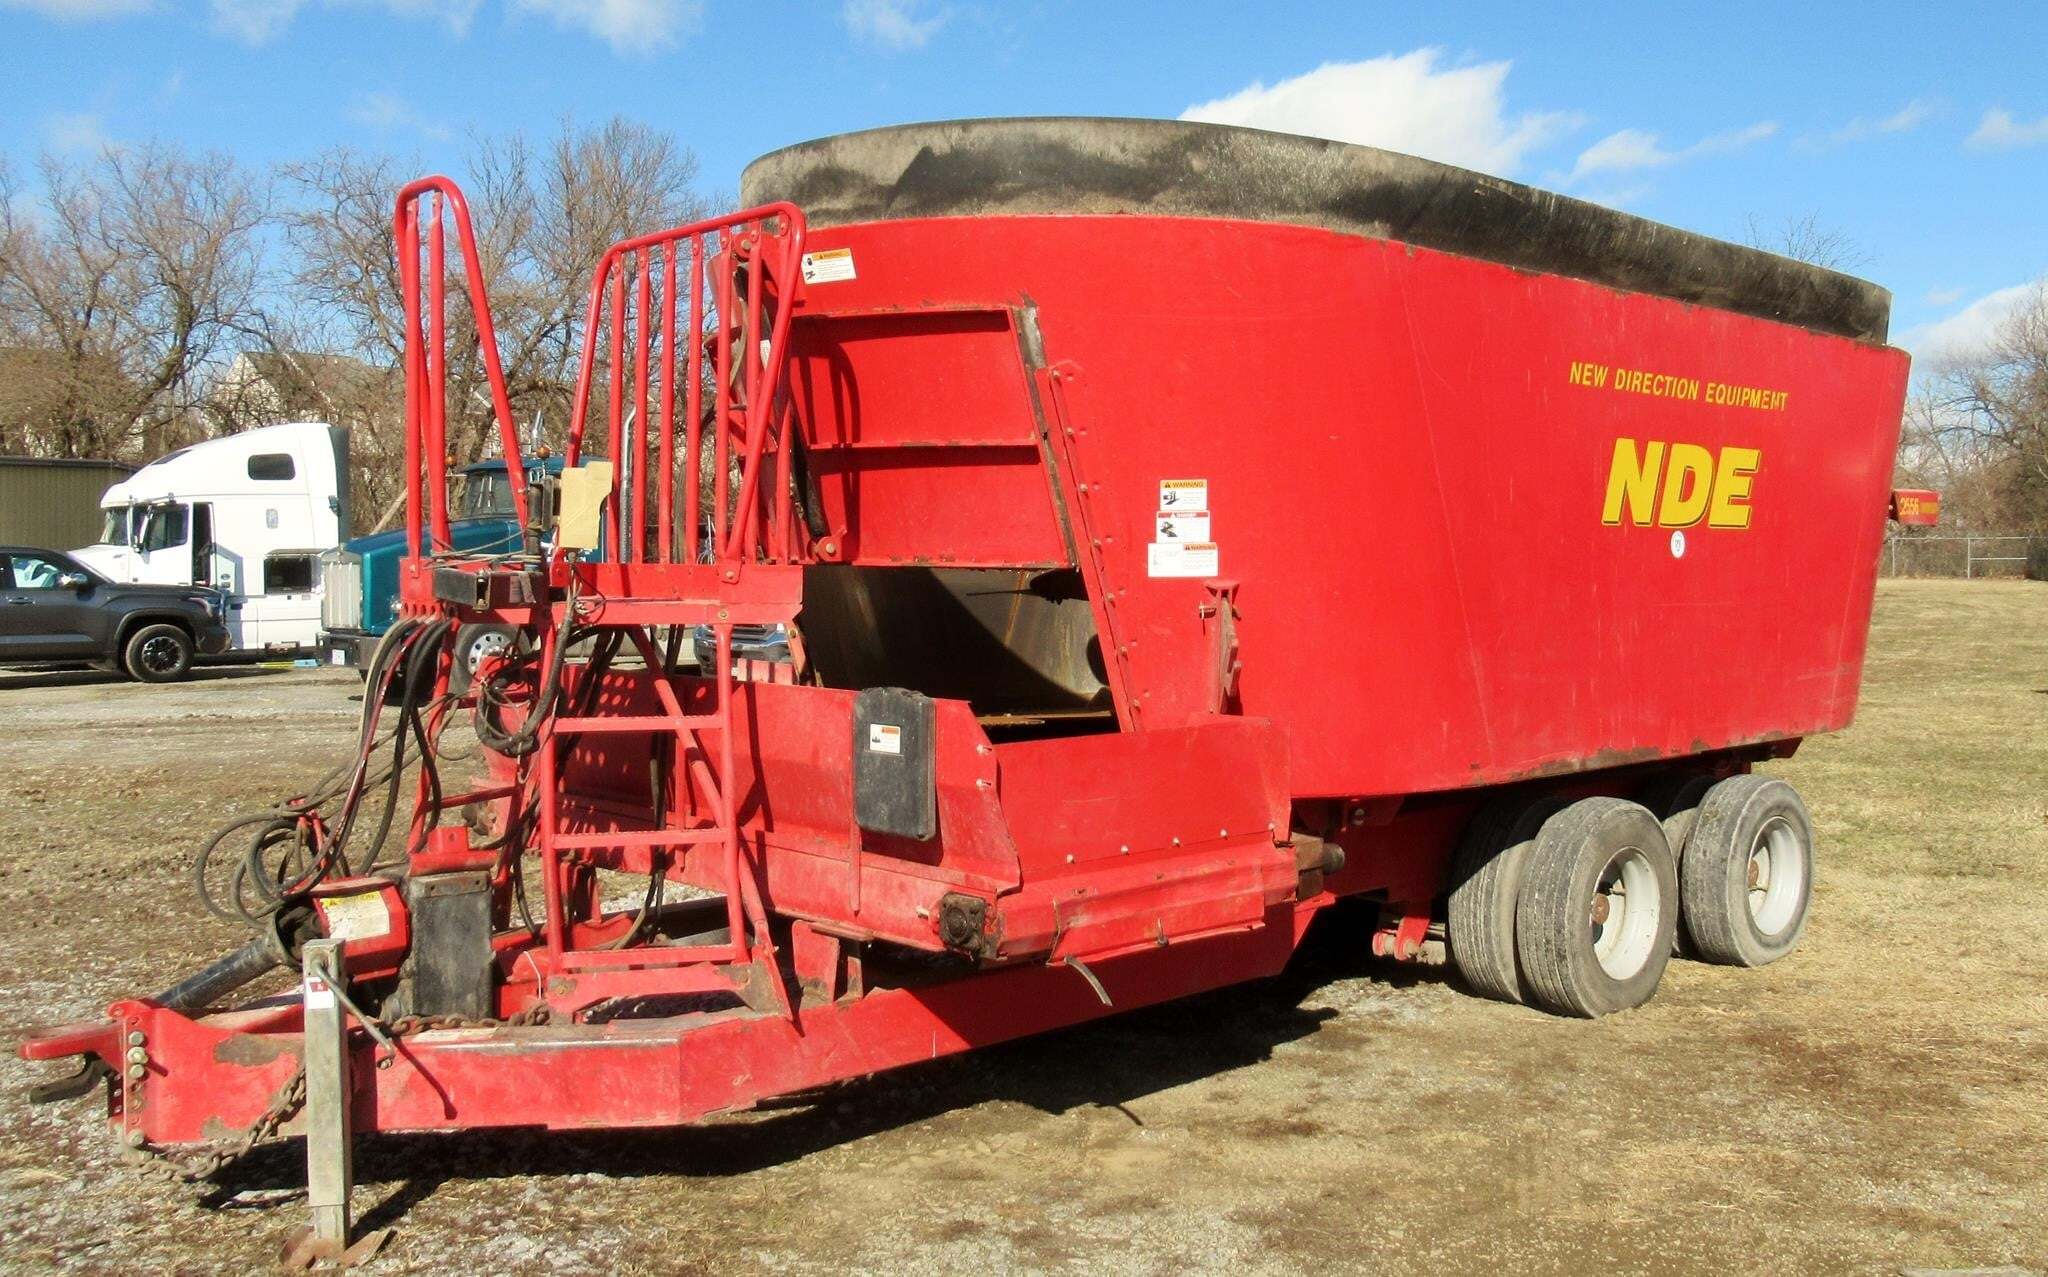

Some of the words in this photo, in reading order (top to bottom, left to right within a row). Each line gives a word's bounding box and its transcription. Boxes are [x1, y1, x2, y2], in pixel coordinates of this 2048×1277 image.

[1570, 361, 1608, 387] NEW
[1614, 368, 1699, 400] DIRECTION
[1705, 382, 1788, 411] EQUIPMENT
[1172, 481, 1203, 489] WARNING
[1601, 437, 1761, 529] NDE
